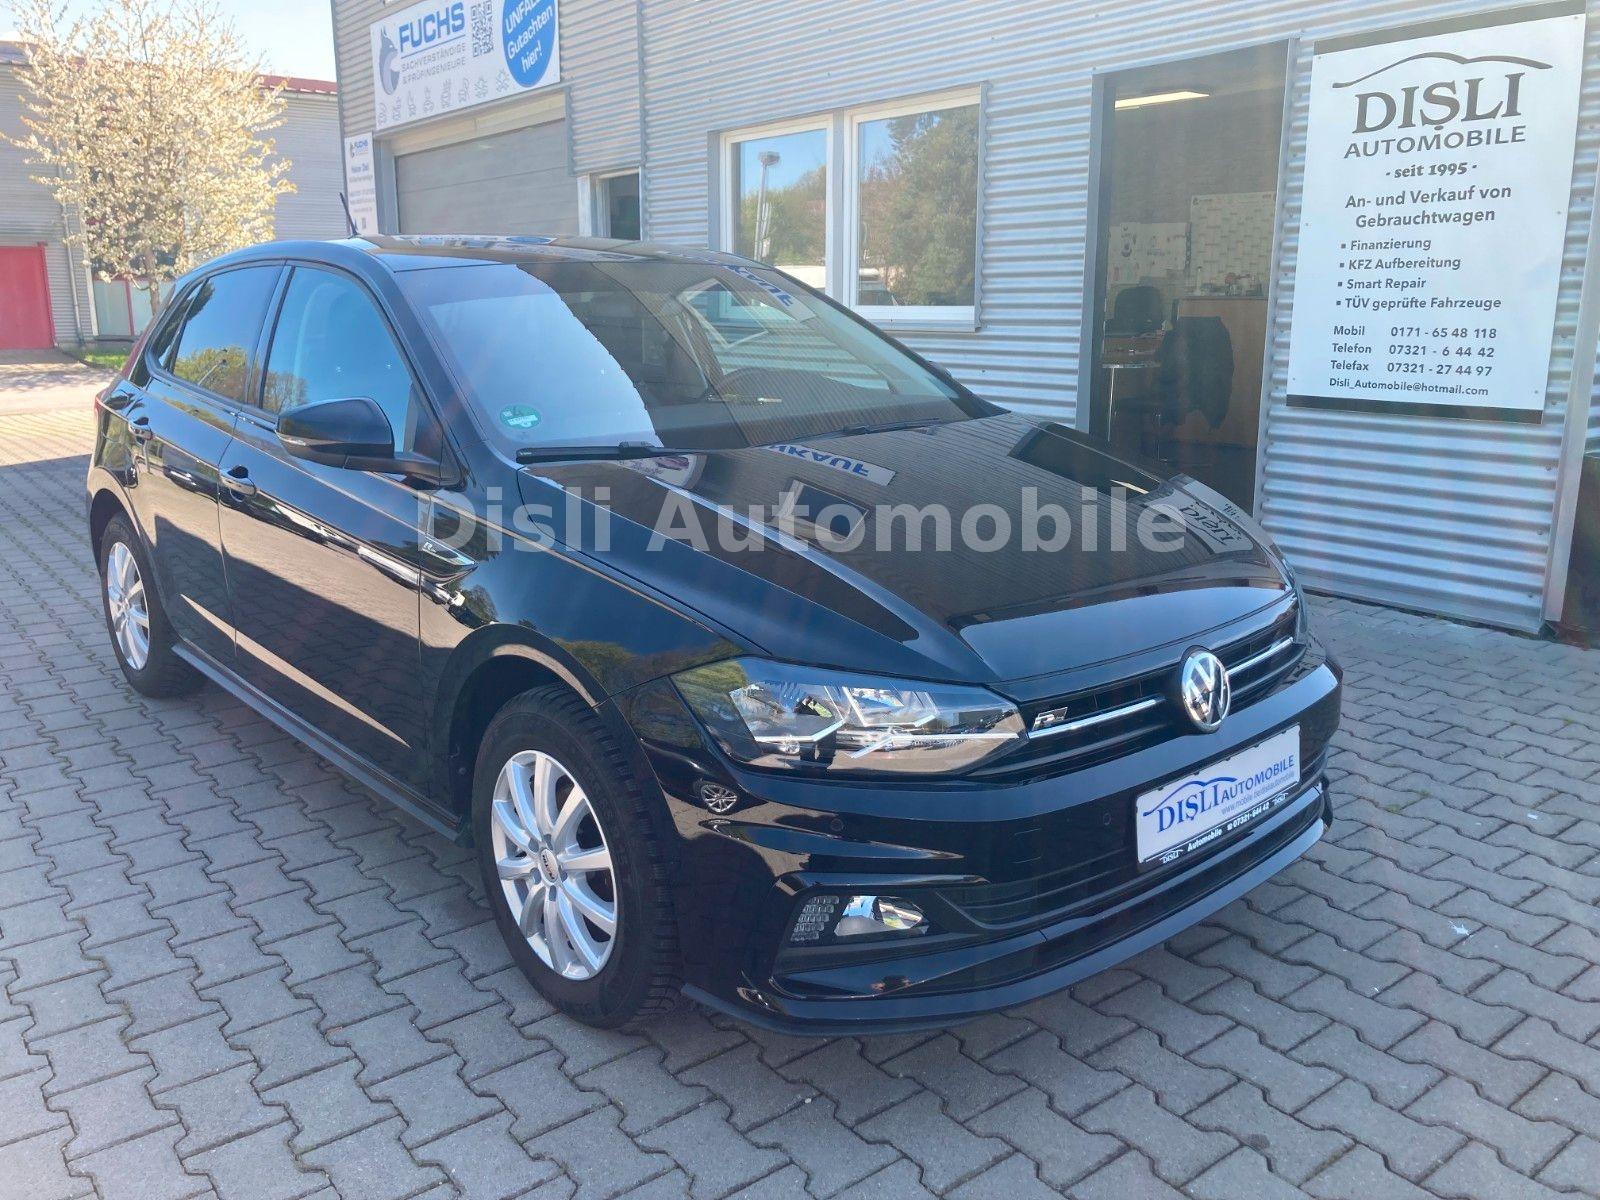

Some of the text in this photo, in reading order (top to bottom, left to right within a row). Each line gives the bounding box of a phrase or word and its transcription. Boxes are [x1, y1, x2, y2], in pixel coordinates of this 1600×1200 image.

[399, 2, 466, 53] FUCHS
[508, 6, 553, 59] Gutachten
[521, 40, 543, 73] hier!
[1344, 125, 1526, 159] AUTOMOBILE
[1394, 164, 1424, 178] seit
[1429, 162, 1468, 176] 1995
[1345, 185, 1511, 208] An- und Verkauf von
[1355, 210, 1495, 228] Gebrauchtwagen
[1350, 238, 1431, 251] Finanzierung
[1349, 257, 1461, 271] KFZ Aufbereitung
[1347, 277, 1426, 291] Smart Repair
[1345, 295, 1501, 311] TÜV geprüfte Fahrzeuge
[1333, 325, 1365, 336] Mobil
[1391, 327, 1420, 337] 0171
[1432, 328, 1448, 338] 65
[1451, 328, 1468, 338] 48
[1474, 328, 1497, 338] 118
[1332, 343, 1372, 354] Telefon
[1389, 344, 1427, 355] 07321
[1442, 347, 1450, 356] 6
[1455, 347, 1472, 357] 44
[1477, 347, 1494, 357] 42
[1331, 360, 1369, 371] Telefax
[1387, 362, 1425, 373] 07321
[1436, 364, 1452, 374] 27
[1455, 366, 1472, 375] 44
[1476, 366, 1492, 376] 97
[1329, 378, 1489, 396] Disli_Automobile@hotmail.com
[1220, 755, 1295, 804] AUTOMOBILE
[1187, 827, 1223, 851] Automobile
